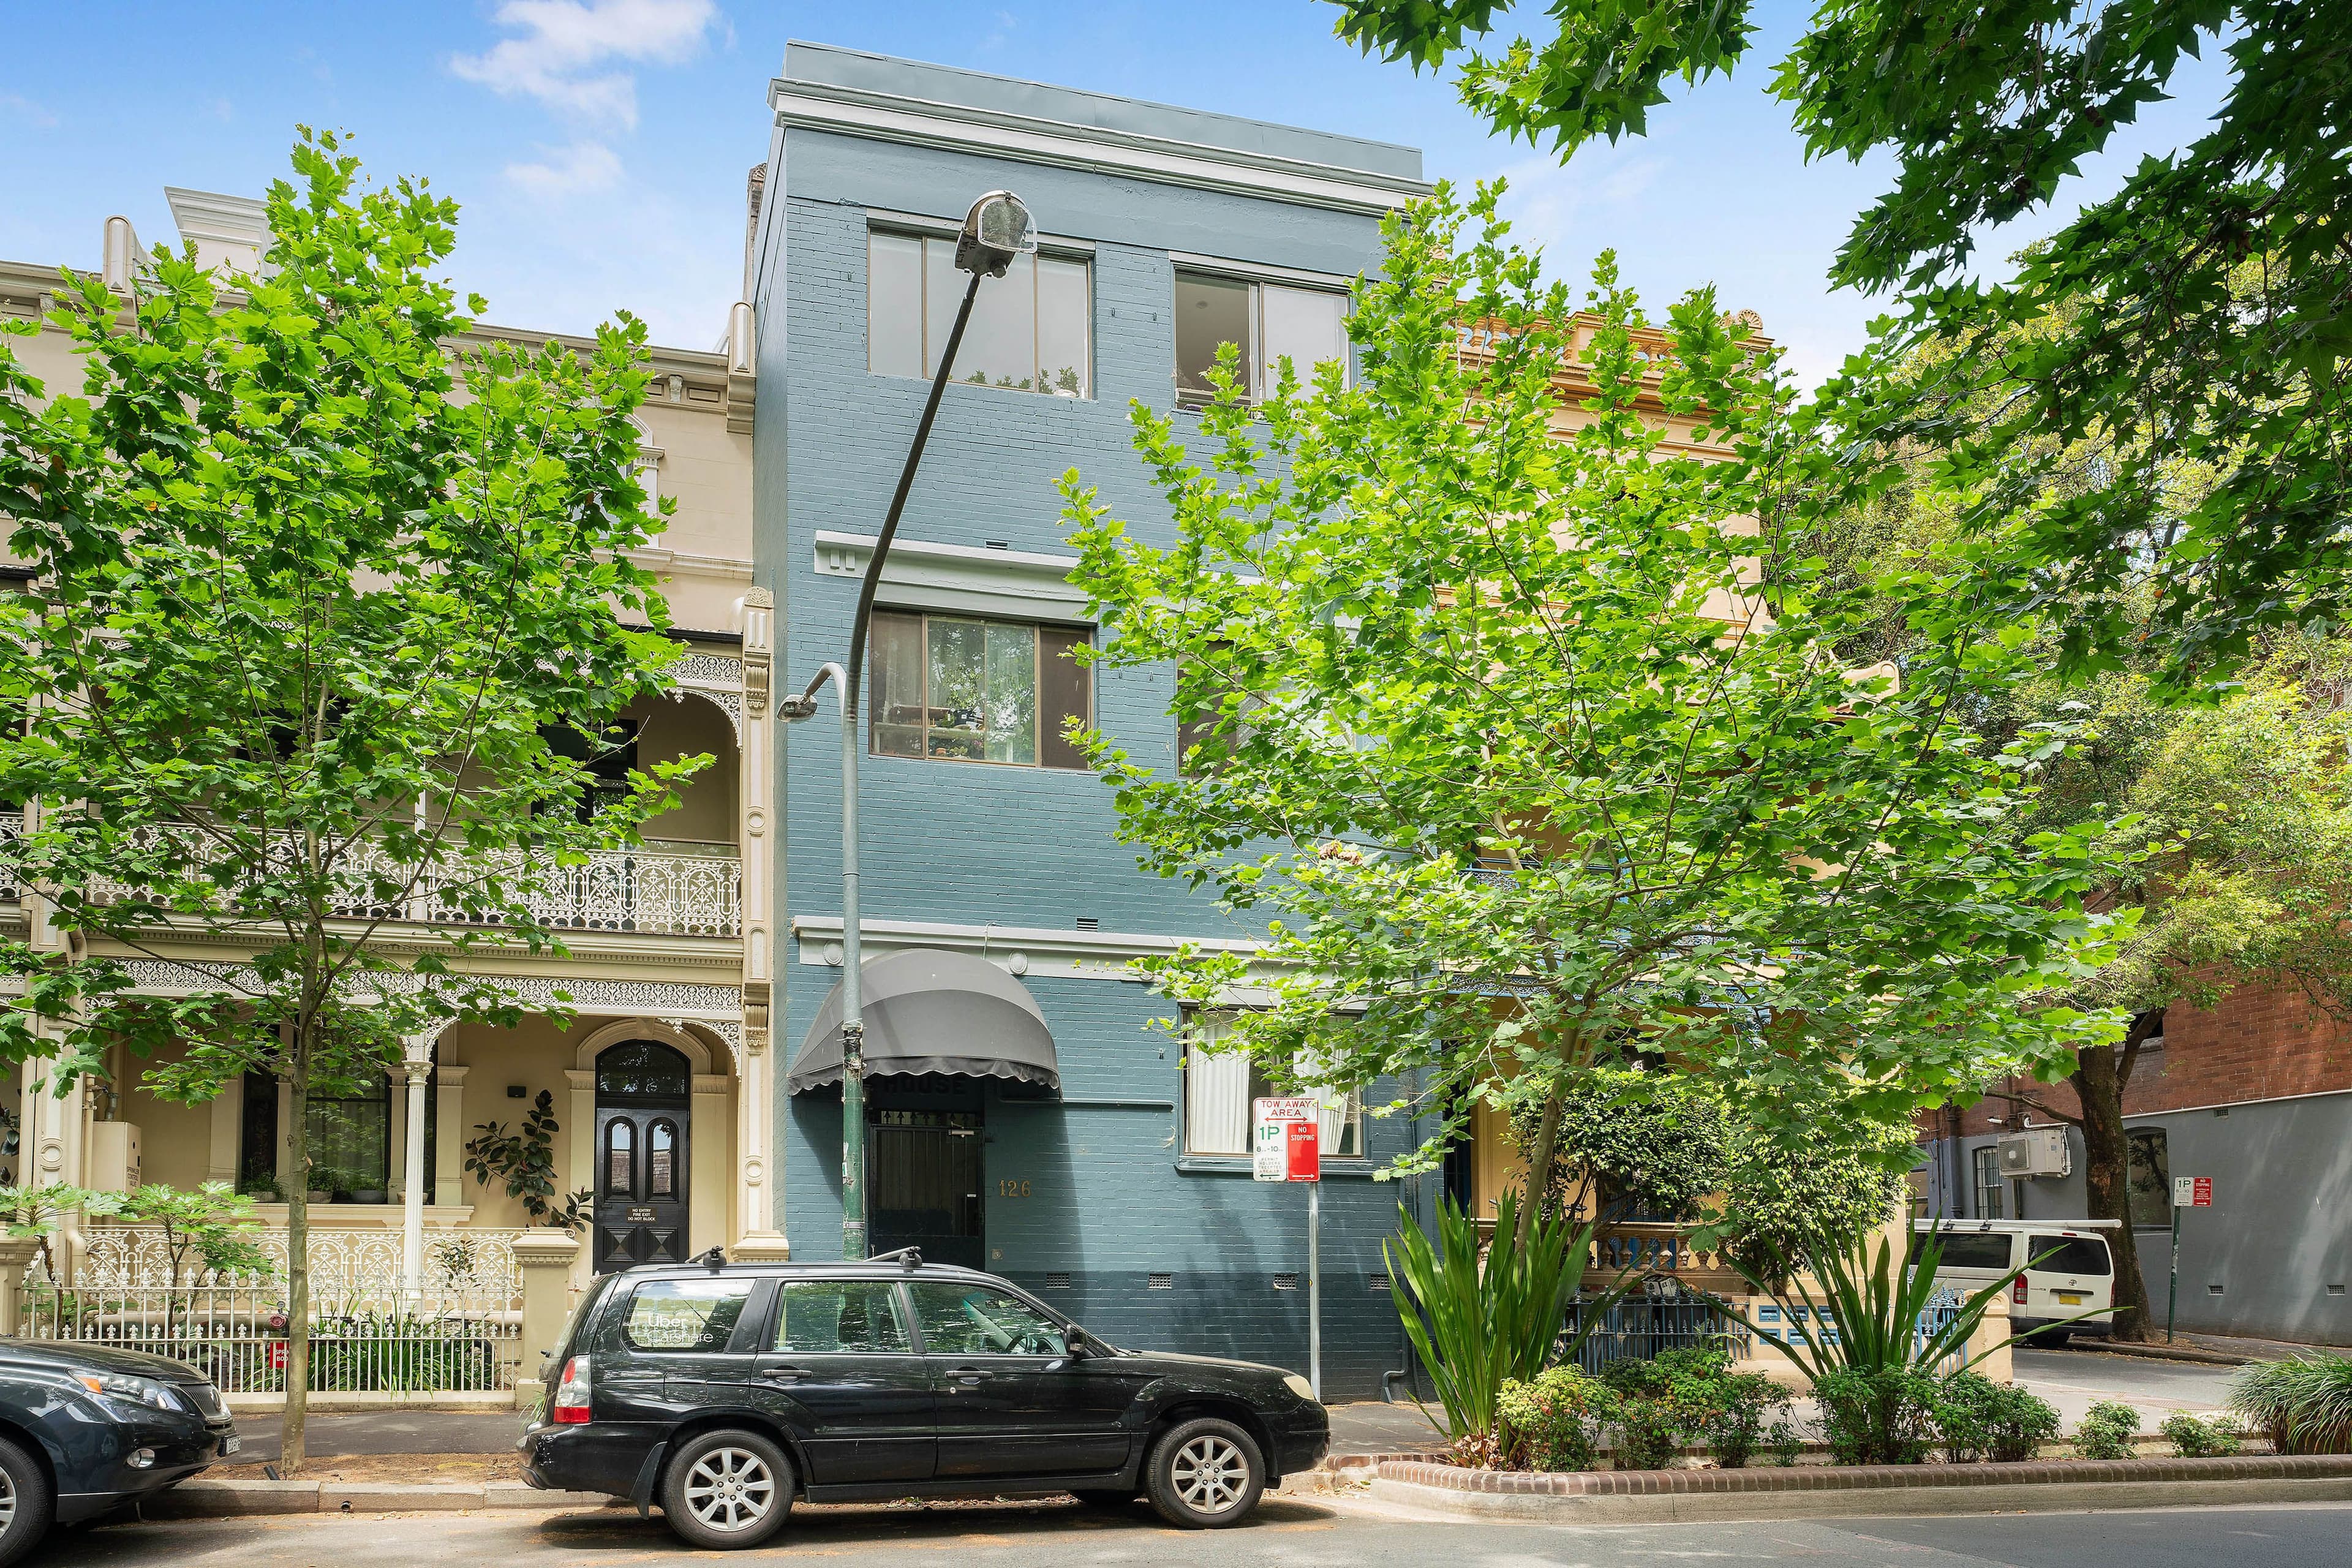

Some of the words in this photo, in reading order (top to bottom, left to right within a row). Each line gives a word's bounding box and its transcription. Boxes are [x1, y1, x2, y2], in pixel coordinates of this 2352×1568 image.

[884, 1076, 967, 1094] HOUSE
[1259, 1126, 1280, 1140] 1P
[999, 1180, 1031, 1197] 126
[648, 1315, 686, 1327] Uber
[647, 1330, 713, 1343] Carshare
